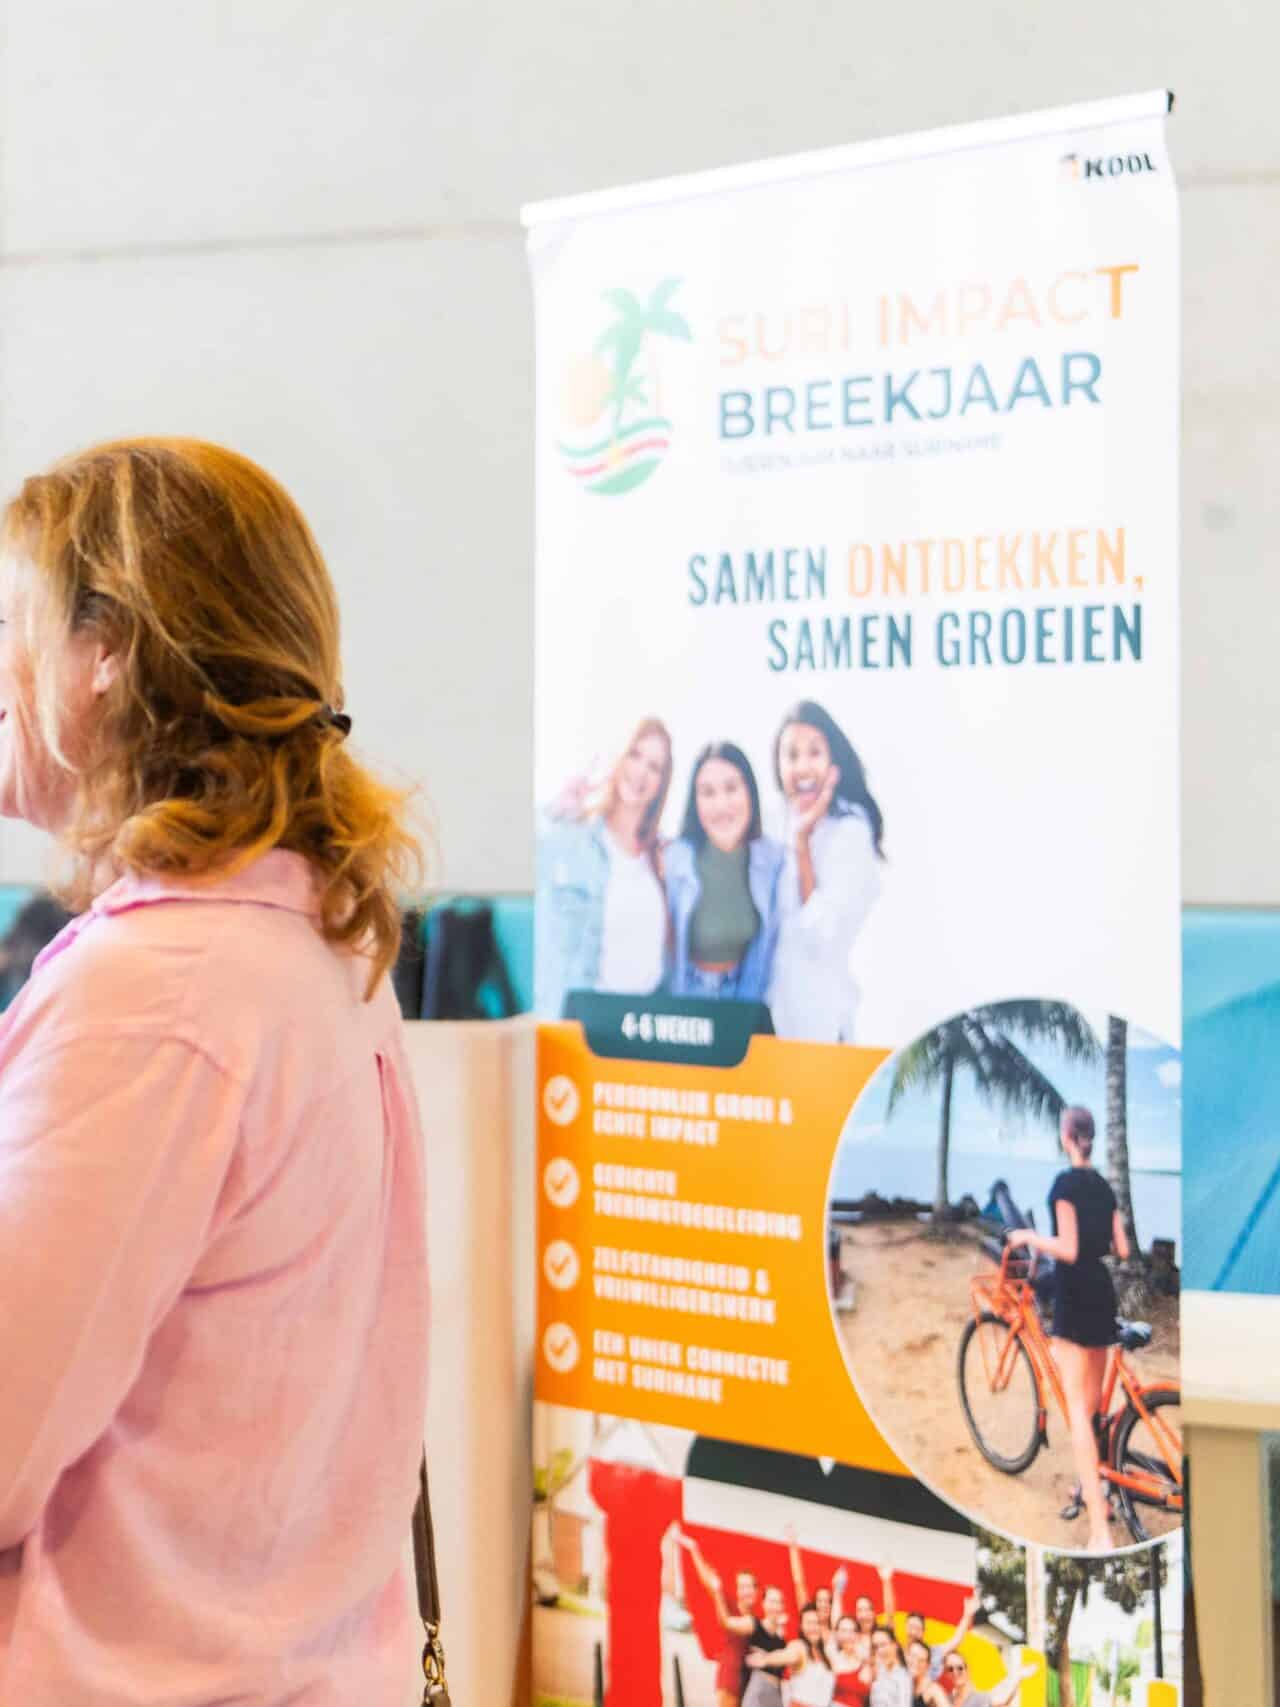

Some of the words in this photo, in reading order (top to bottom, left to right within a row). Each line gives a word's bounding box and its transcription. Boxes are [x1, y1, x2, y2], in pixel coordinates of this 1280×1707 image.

[879, 264, 1140, 347] IMPACT
[718, 351, 1104, 440] BREEKJAAR
[688, 546, 828, 607] SAMEN
[846, 526, 1145, 599] ONTDEKKEN,
[766, 613, 914, 673] SAMEN
[935, 603, 1144, 669] GROEIEN
